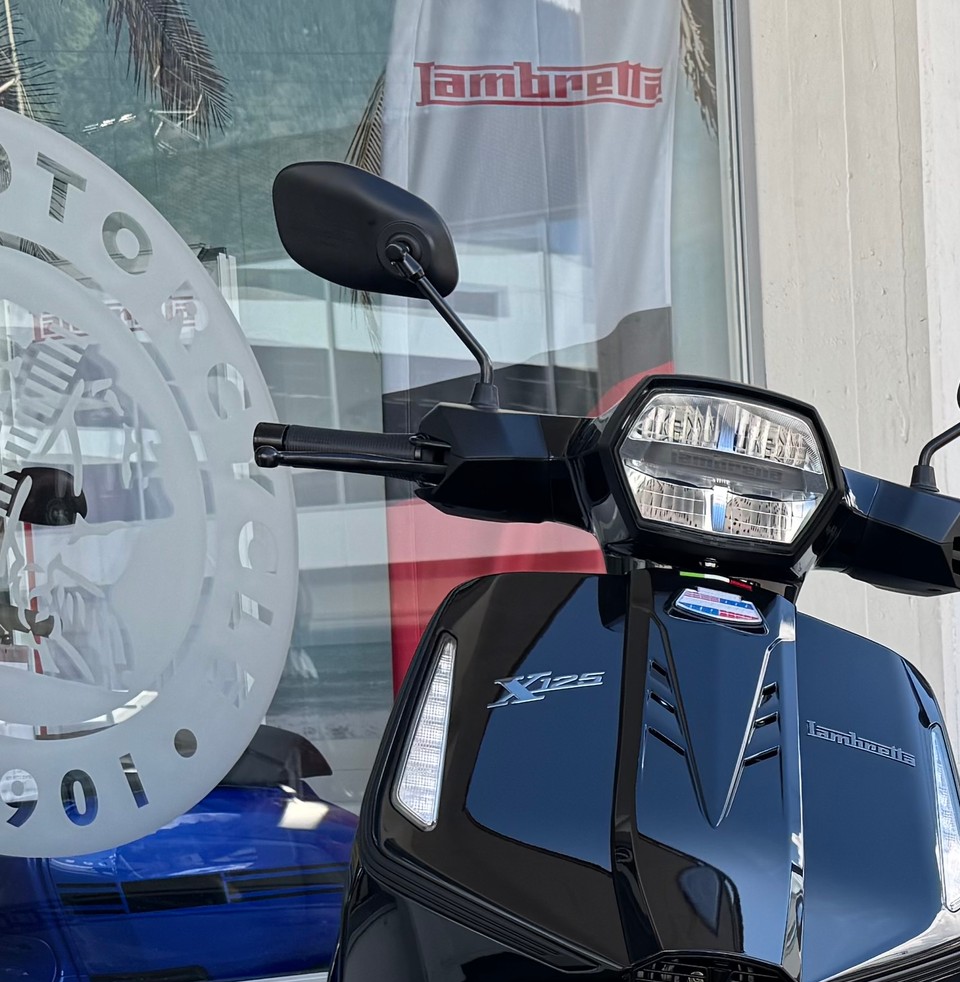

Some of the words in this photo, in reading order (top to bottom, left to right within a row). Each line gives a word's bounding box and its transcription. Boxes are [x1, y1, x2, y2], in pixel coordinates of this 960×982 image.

[414, 60, 662, 108] Lambretta
[487, 671, 605, 708] X125
[806, 720, 916, 767] Lambretta
